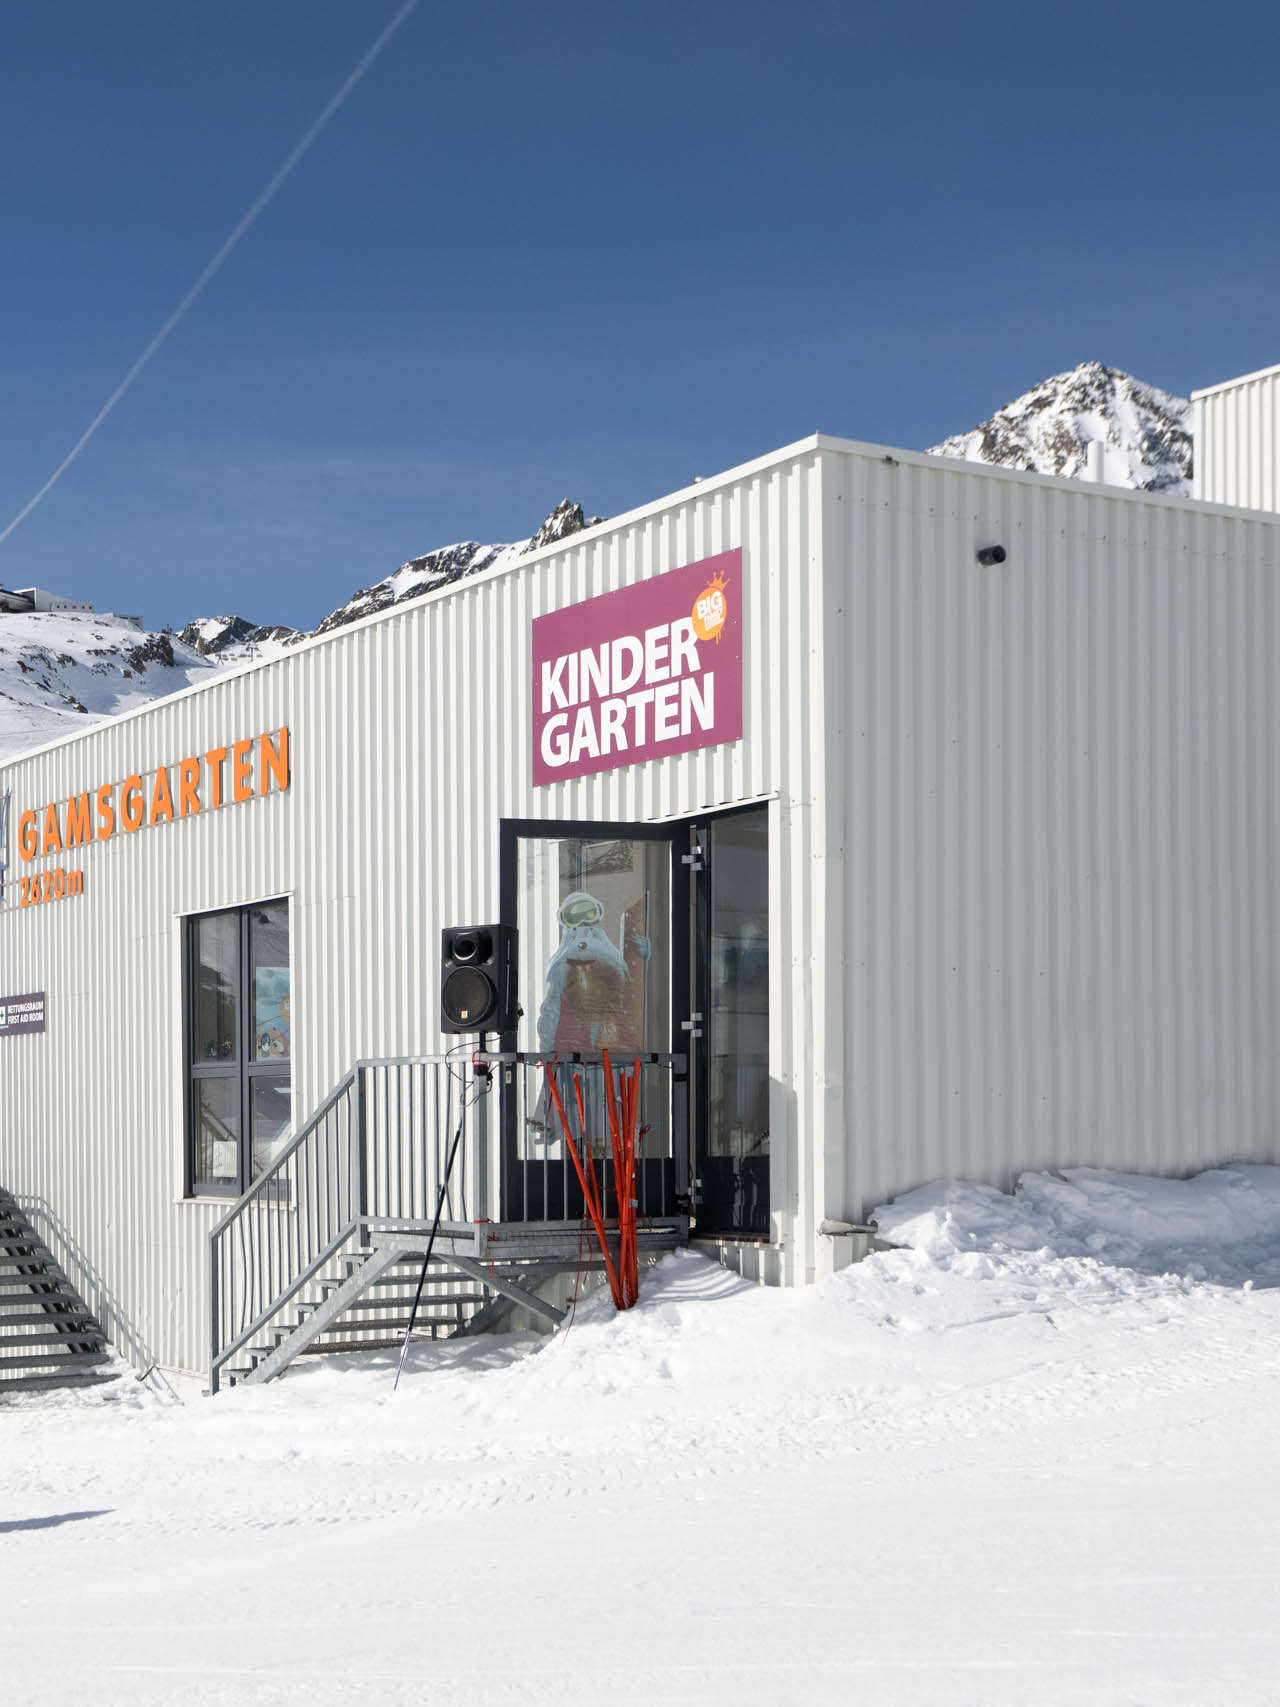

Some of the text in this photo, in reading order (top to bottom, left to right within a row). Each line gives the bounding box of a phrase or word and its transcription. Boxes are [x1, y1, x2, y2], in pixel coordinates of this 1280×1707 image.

[696, 591, 723, 620] BIG
[541, 616, 701, 714] KINDER
[540, 671, 715, 767] GARTEN
[18, 726, 289, 862] GAMSGARTEN
[20, 867, 84, 907] 2620m
[7, 1012, 43, 1025] FIRST AID ROOM
